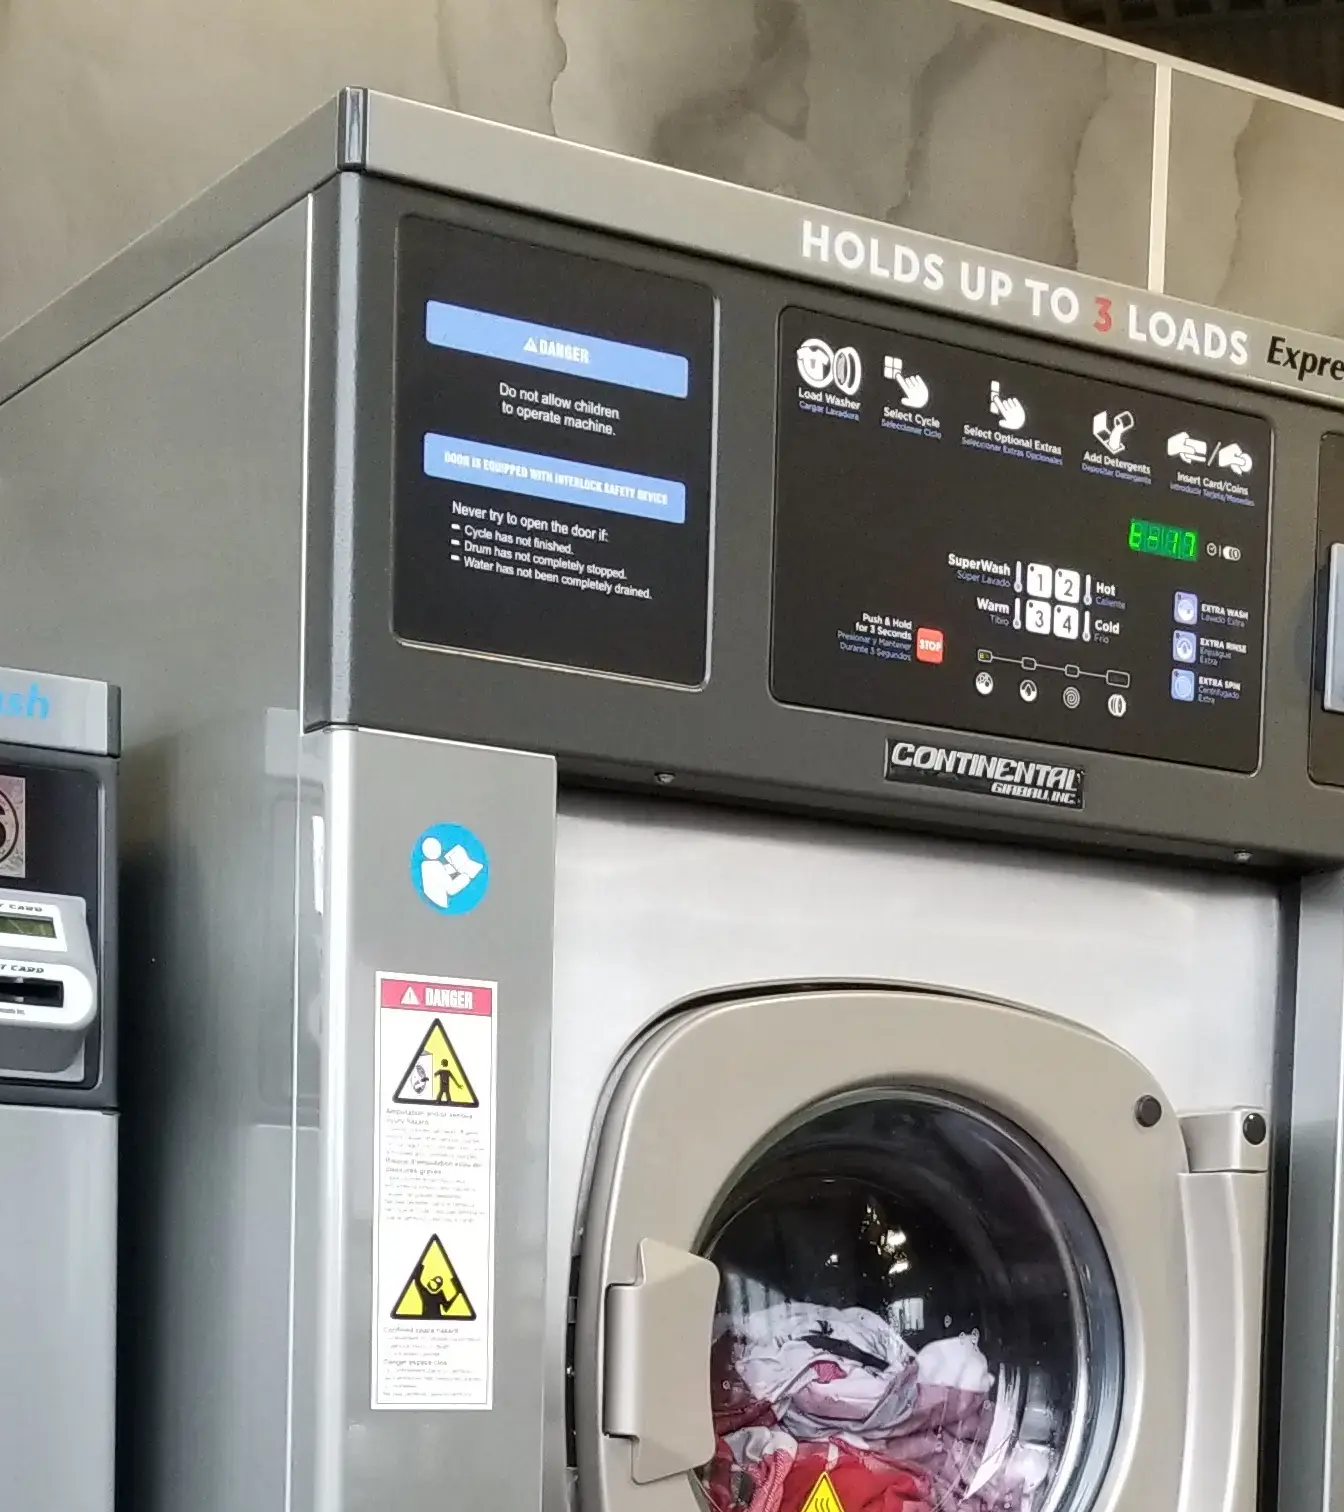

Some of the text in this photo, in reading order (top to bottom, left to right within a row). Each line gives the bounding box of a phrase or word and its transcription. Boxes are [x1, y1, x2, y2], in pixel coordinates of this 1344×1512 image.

[801, 220, 1249, 366] HOLDS UP TO 3 LOADS
[539, 339, 589, 364] DANGER
[500, 382, 620, 420] Do not allow children
[798, 387, 861, 410] Load Washer
[502, 401, 616, 436] to operate machine.
[884, 407, 940, 429] Select Cycle
[964, 425, 1061, 455] Select Optional Extras
[1084, 451, 1151, 474] Add Detergents
[1177, 472, 1249, 495] Insert Card/Coins
[452, 501, 486, 520] Never
[490, 508, 504, 525] try
[507, 511, 517, 525] to
[521, 515, 547, 534] open
[551, 519, 569, 533] the
[571, 524, 596, 540] door
[948, 553, 1010, 576] SuperWash
[1037, 574, 1073, 597] 1 2
[1096, 582, 1115, 596] Hot
[977, 597, 1009, 614] Warm
[1035, 610, 1072, 633] 3 4
[1095, 619, 1119, 634] Cold
[919, 639, 941, 652] STOP
[891, 742, 1077, 792] CONTINENTAL
[8, 902, 43, 912] CARD
[10, 964, 44, 974] CARD
[425, 986, 473, 1010] DANGER
